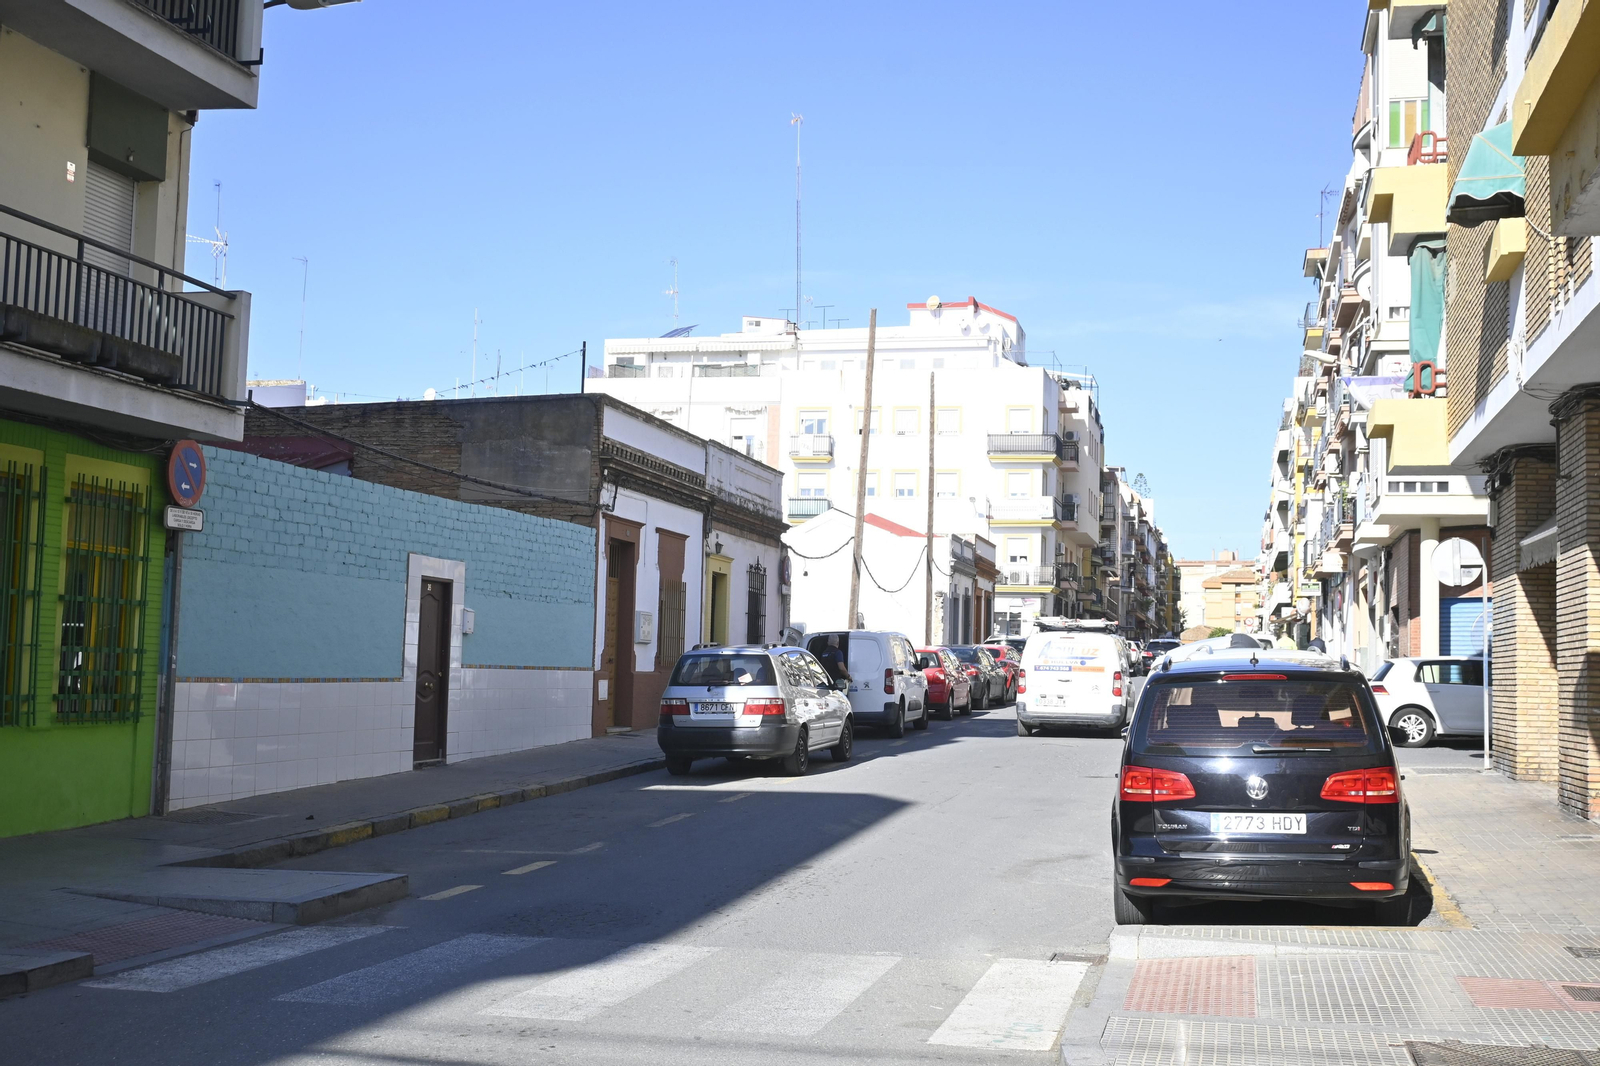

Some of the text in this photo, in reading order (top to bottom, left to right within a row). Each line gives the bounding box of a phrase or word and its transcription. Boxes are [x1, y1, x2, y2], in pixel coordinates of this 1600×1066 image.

[700, 703, 718, 711] 8671
[1223, 816, 1303, 831] 2773 HDY
